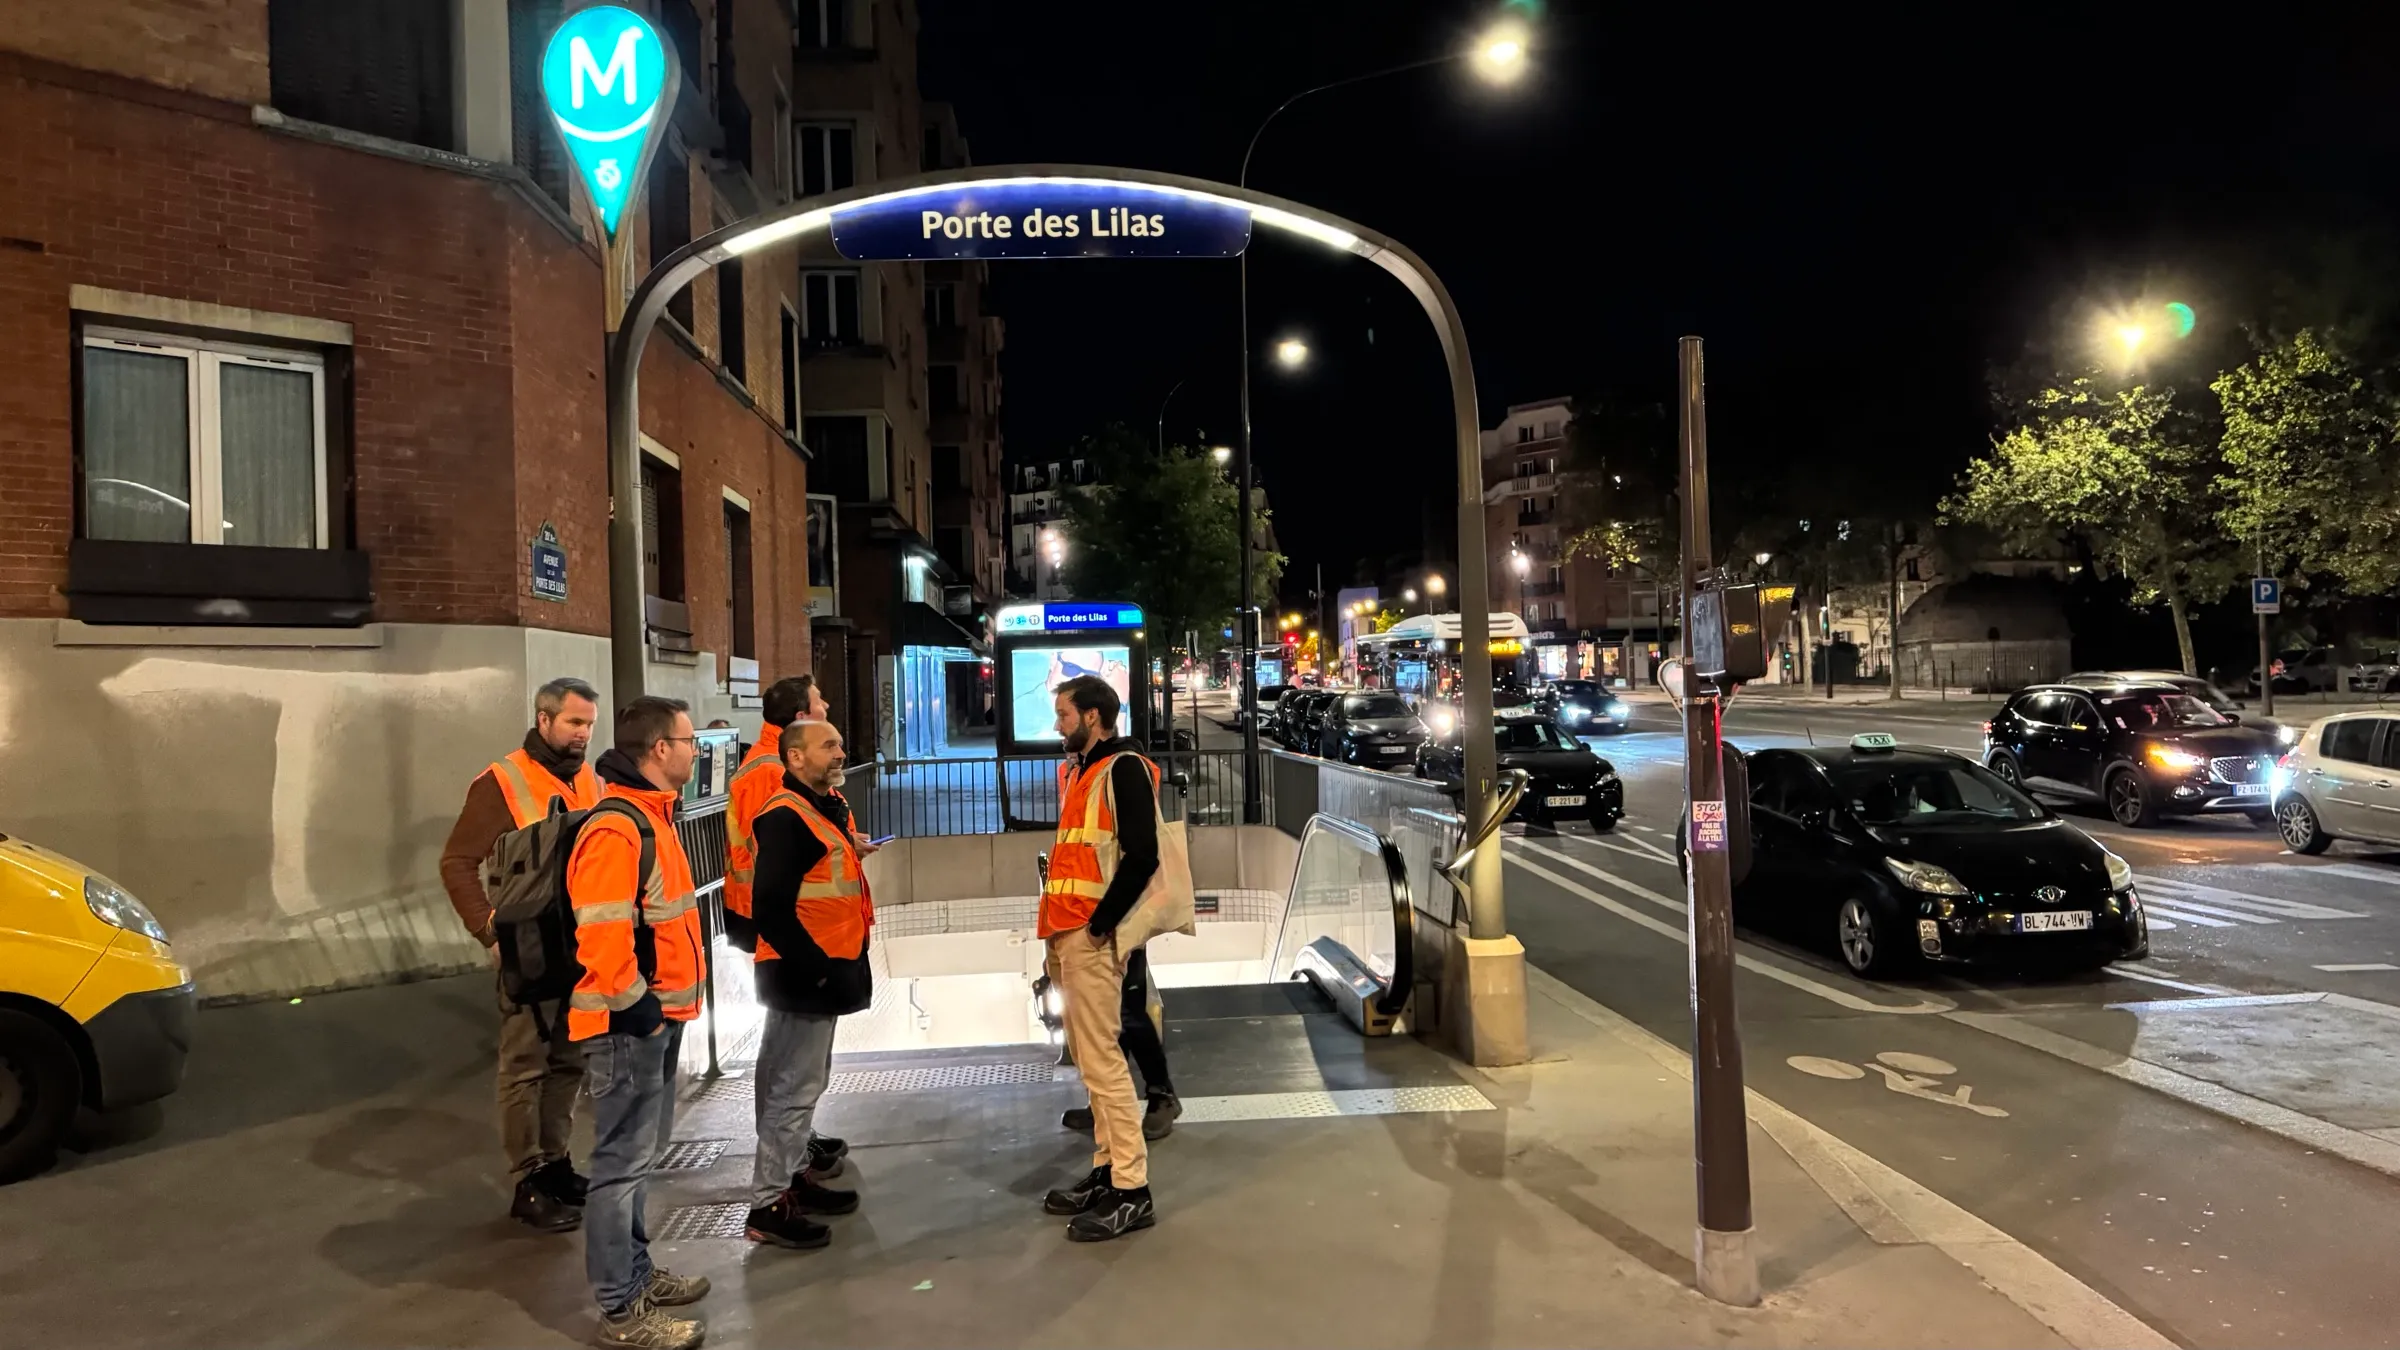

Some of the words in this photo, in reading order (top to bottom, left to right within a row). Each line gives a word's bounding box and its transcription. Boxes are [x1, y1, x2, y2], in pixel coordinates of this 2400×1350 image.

[921, 210, 1013, 239] Porte
[1022, 208, 1080, 238] des
[1091, 207, 1165, 237] Lilas
[543, 553, 559, 567] AVENUE
[536, 576, 548, 590] PORTE
[548, 579, 556, 591] DES
[556, 581, 565, 593] LILAS
[2260, 583, 2272, 600] P
[1048, 614, 1071, 623] Porte
[1072, 613, 1087, 622] des
[1088, 612, 1108, 621] Lilas
[1865, 735, 1891, 746] TAXI
[1697, 803, 1722, 812] STOP
